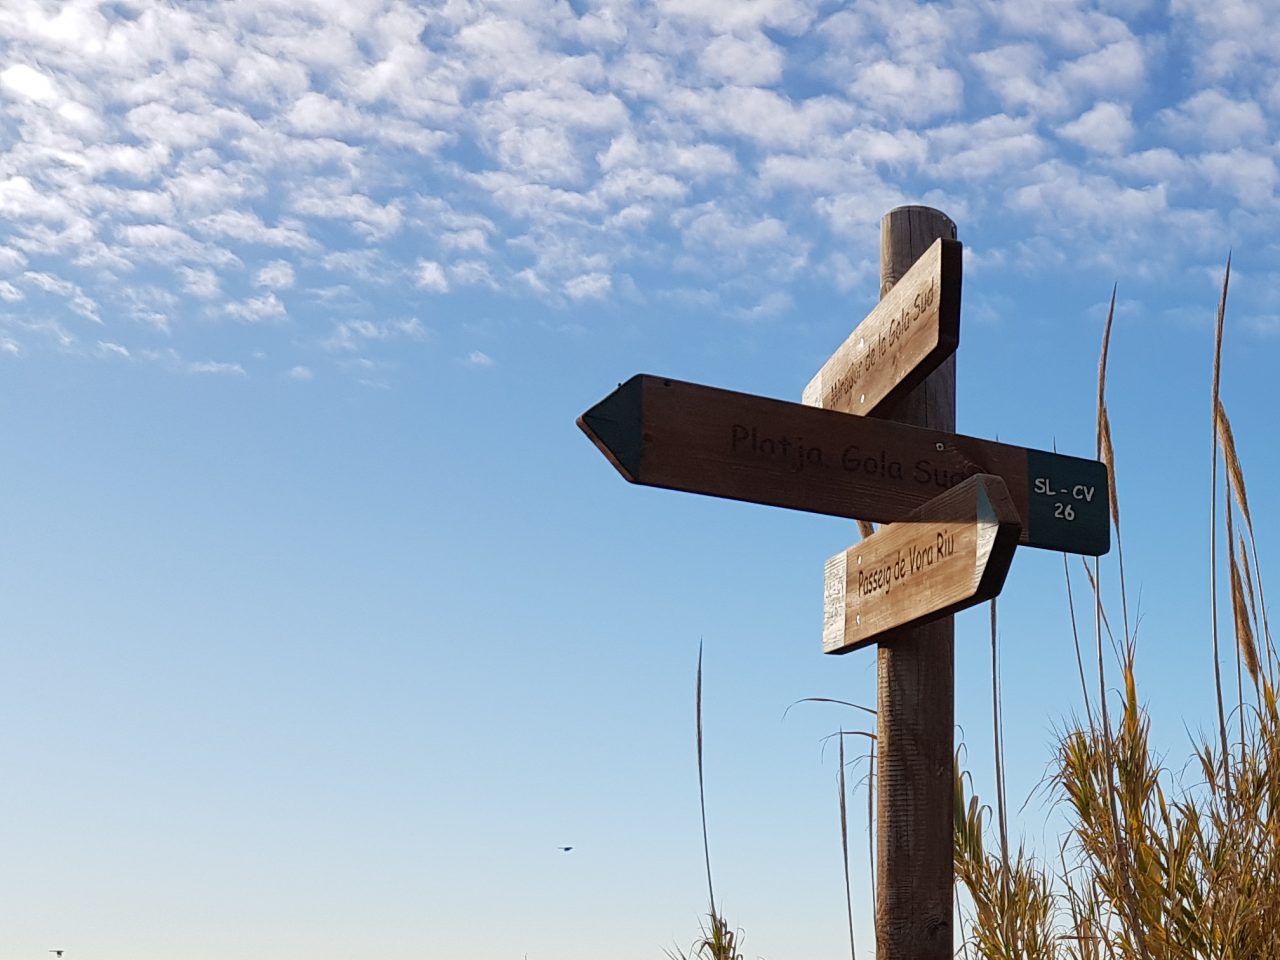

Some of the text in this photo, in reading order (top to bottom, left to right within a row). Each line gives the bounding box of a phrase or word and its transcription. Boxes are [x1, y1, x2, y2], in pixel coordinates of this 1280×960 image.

[865, 344, 876, 372] de
[878, 332, 887, 359] la
[889, 308, 910, 347] Gola
[913, 276, 935, 321] Sud
[731, 424, 823, 473] Platja
[841, 445, 904, 481] Gola
[1054, 503, 1075, 520] 26
[858, 566, 891, 598] Passeig
[894, 551, 906, 580] de
[909, 545, 933, 575] Vora
[936, 529, 954, 560] Riu
